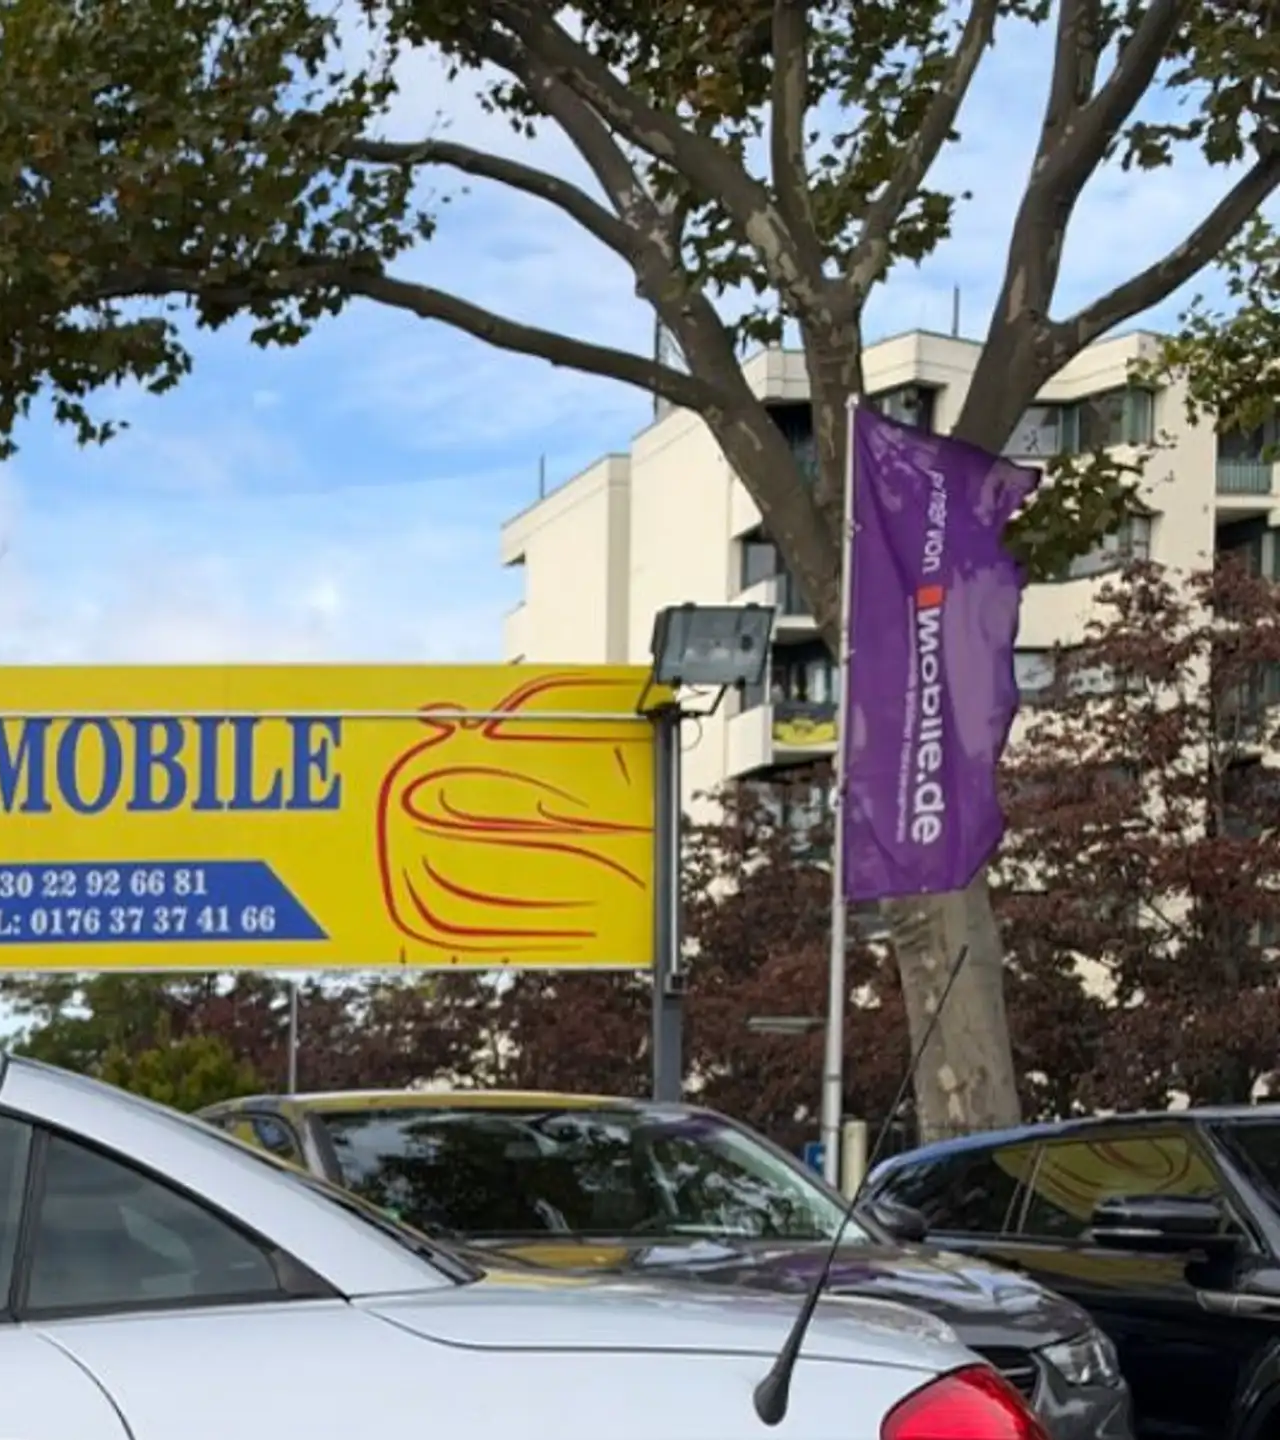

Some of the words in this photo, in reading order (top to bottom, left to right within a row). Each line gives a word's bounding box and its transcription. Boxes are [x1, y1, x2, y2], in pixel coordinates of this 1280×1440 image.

[921, 529, 945, 575] von
[911, 606, 946, 844] mobile.de
[42, 870, 77, 897] 22
[86, 869, 120, 896] 92
[130, 868, 165, 896] 66
[173, 868, 208, 895] 81
[30, 908, 101, 936] 0176
[109, 907, 144, 935] 37
[153, 906, 188, 934] 37
[197, 905, 231, 933] 41
[241, 904, 276, 932] 66
